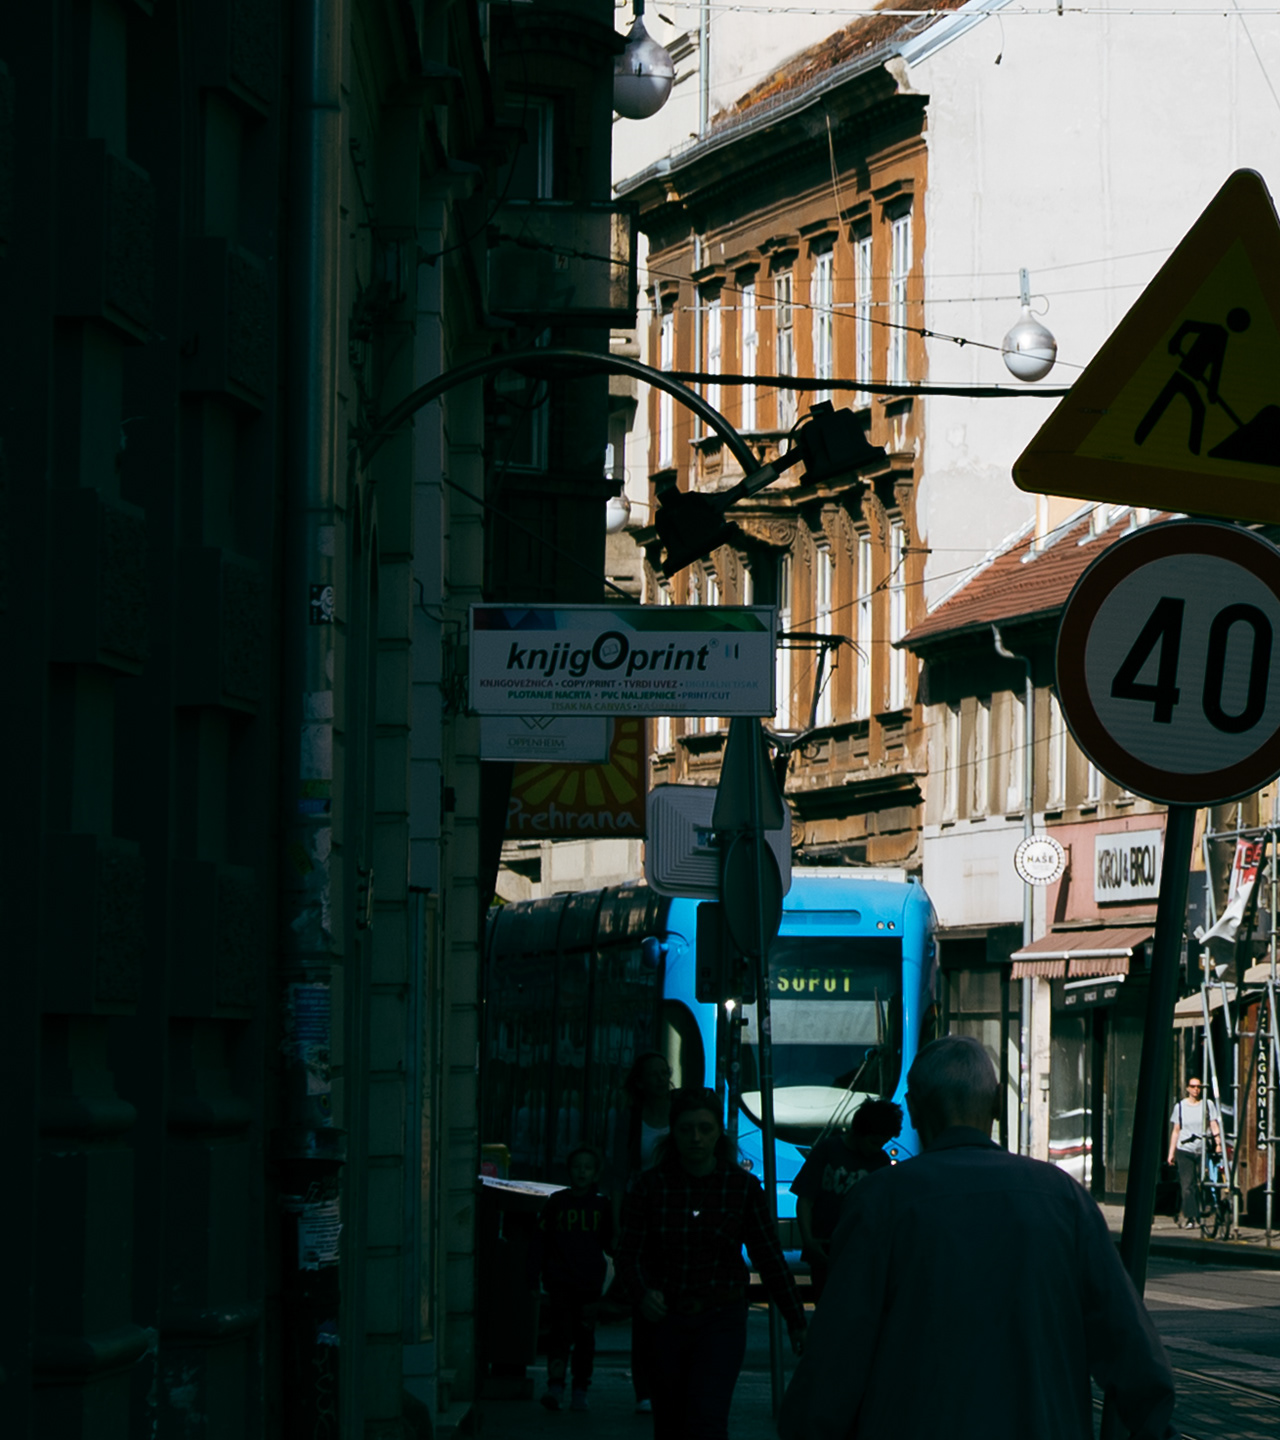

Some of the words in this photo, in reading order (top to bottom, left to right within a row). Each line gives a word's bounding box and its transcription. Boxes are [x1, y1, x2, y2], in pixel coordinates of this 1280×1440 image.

[507, 630, 709, 677] knjigOprint
[1110, 596, 1274, 734] 40
[508, 691, 553, 699] PLOTANJE
[555, 691, 592, 699] NACRTA
[601, 691, 620, 699] PVC
[621, 691, 676, 700] NALJEPNICE
[561, 680, 616, 688] COPY/PRINT
[624, 680, 651, 688] TVRDI
[653, 680, 678, 688] UVEZ
[506, 797, 641, 831] Prehrana
[1026, 852, 1055, 864] NAŠE
[1130, 845, 1156, 888] BROJ
